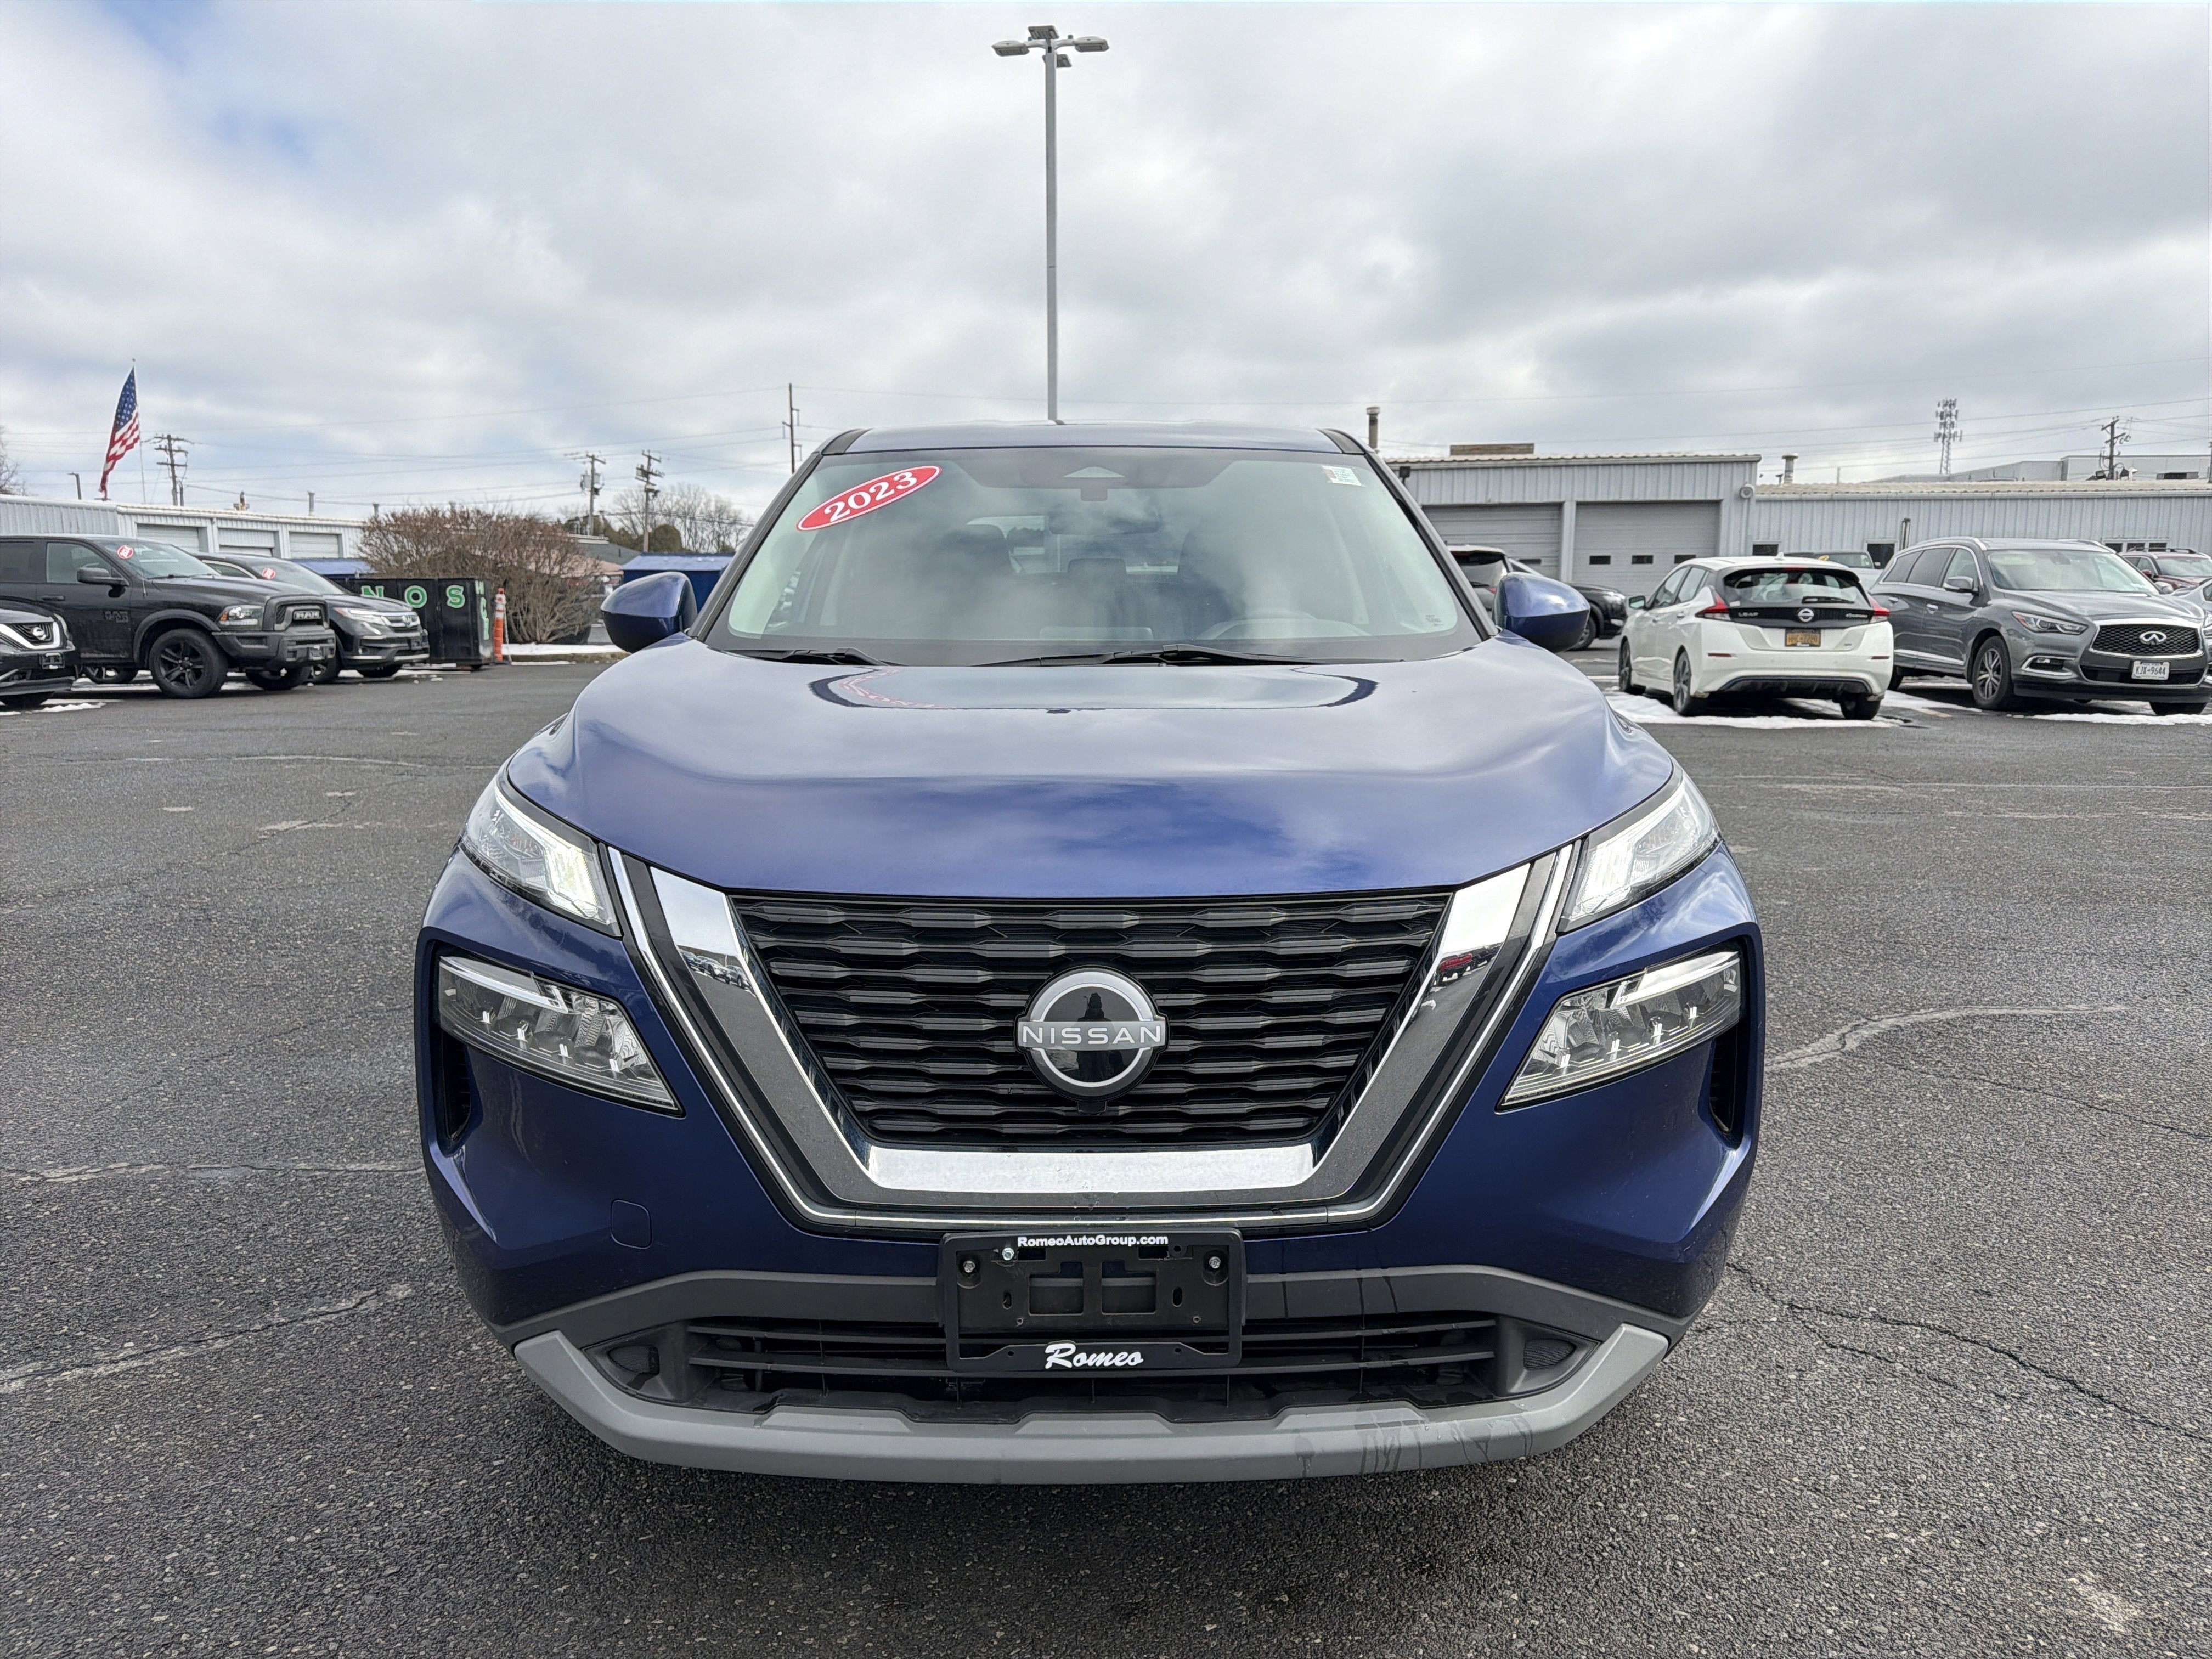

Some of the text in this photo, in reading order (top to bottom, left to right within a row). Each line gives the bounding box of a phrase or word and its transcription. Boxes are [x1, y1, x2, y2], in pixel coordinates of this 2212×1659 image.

[824, 472, 917, 522] 2023
[295, 611, 320, 619] RAM
[2136, 666, 2166, 675] KJX-9644
[1023, 1026, 1161, 1045] NISSAN
[1018, 1235, 1169, 1246] RomeoAutoGroup.com
[1045, 1343, 1143, 1369] Romeo
